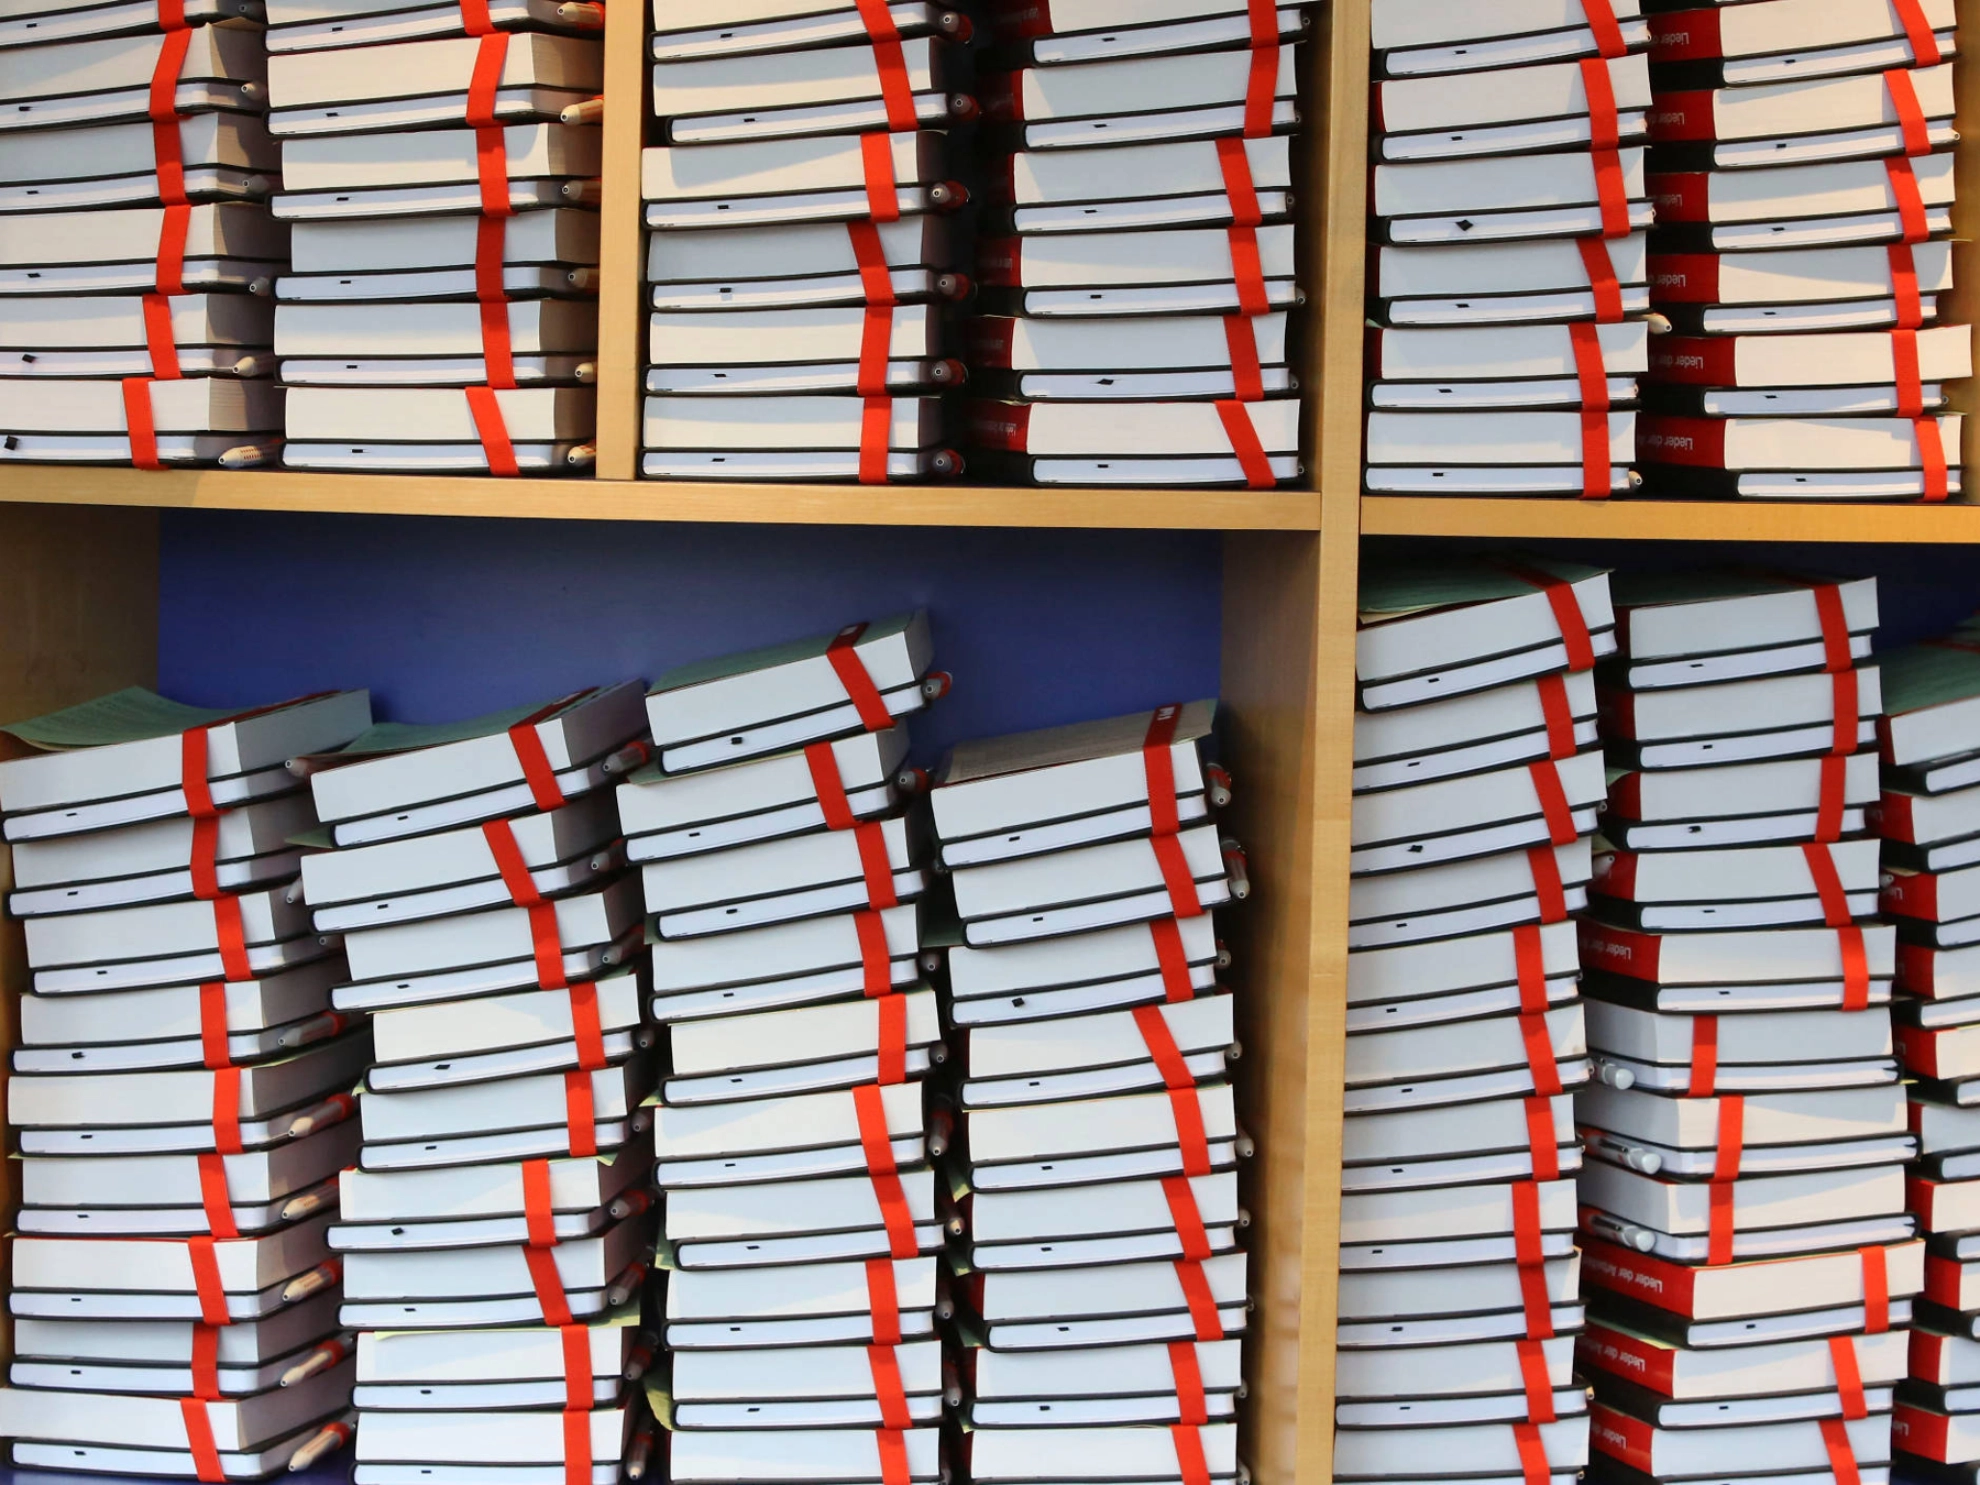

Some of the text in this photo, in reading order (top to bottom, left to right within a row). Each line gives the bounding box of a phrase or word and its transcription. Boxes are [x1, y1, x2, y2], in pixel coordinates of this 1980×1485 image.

[1661, 32, 1689, 45] Lieder
[1657, 274, 1686, 287] Lieder
[1675, 355, 1703, 370] Lieder
[1664, 435, 1693, 450] Lieder
[1606, 944, 1631, 959] Lieder
[1635, 1273, 1662, 1292] Lieder
[1619, 1352, 1644, 1371] Lieder
